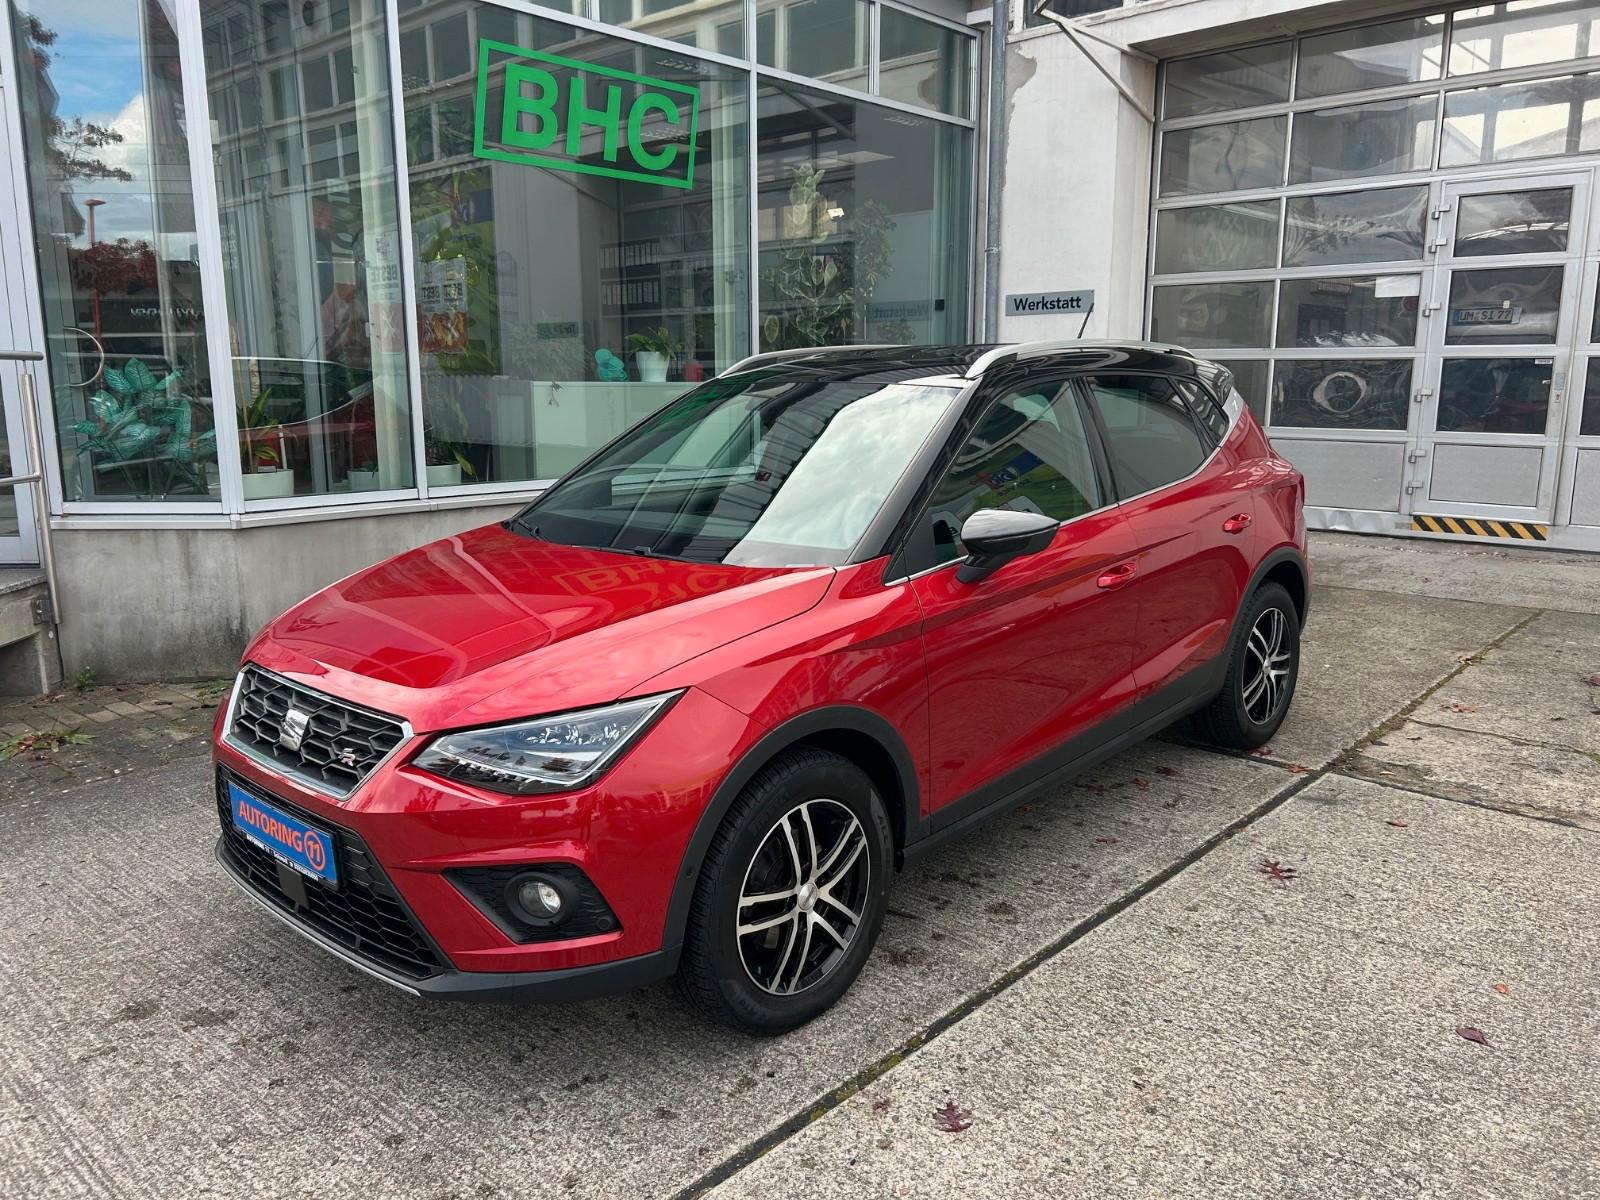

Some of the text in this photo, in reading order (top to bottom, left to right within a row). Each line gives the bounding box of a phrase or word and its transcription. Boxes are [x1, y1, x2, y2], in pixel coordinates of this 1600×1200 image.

[501, 63, 680, 171] BHC
[1013, 296, 1082, 311] Werkstatt
[239, 800, 321, 862] AUTORING 11
